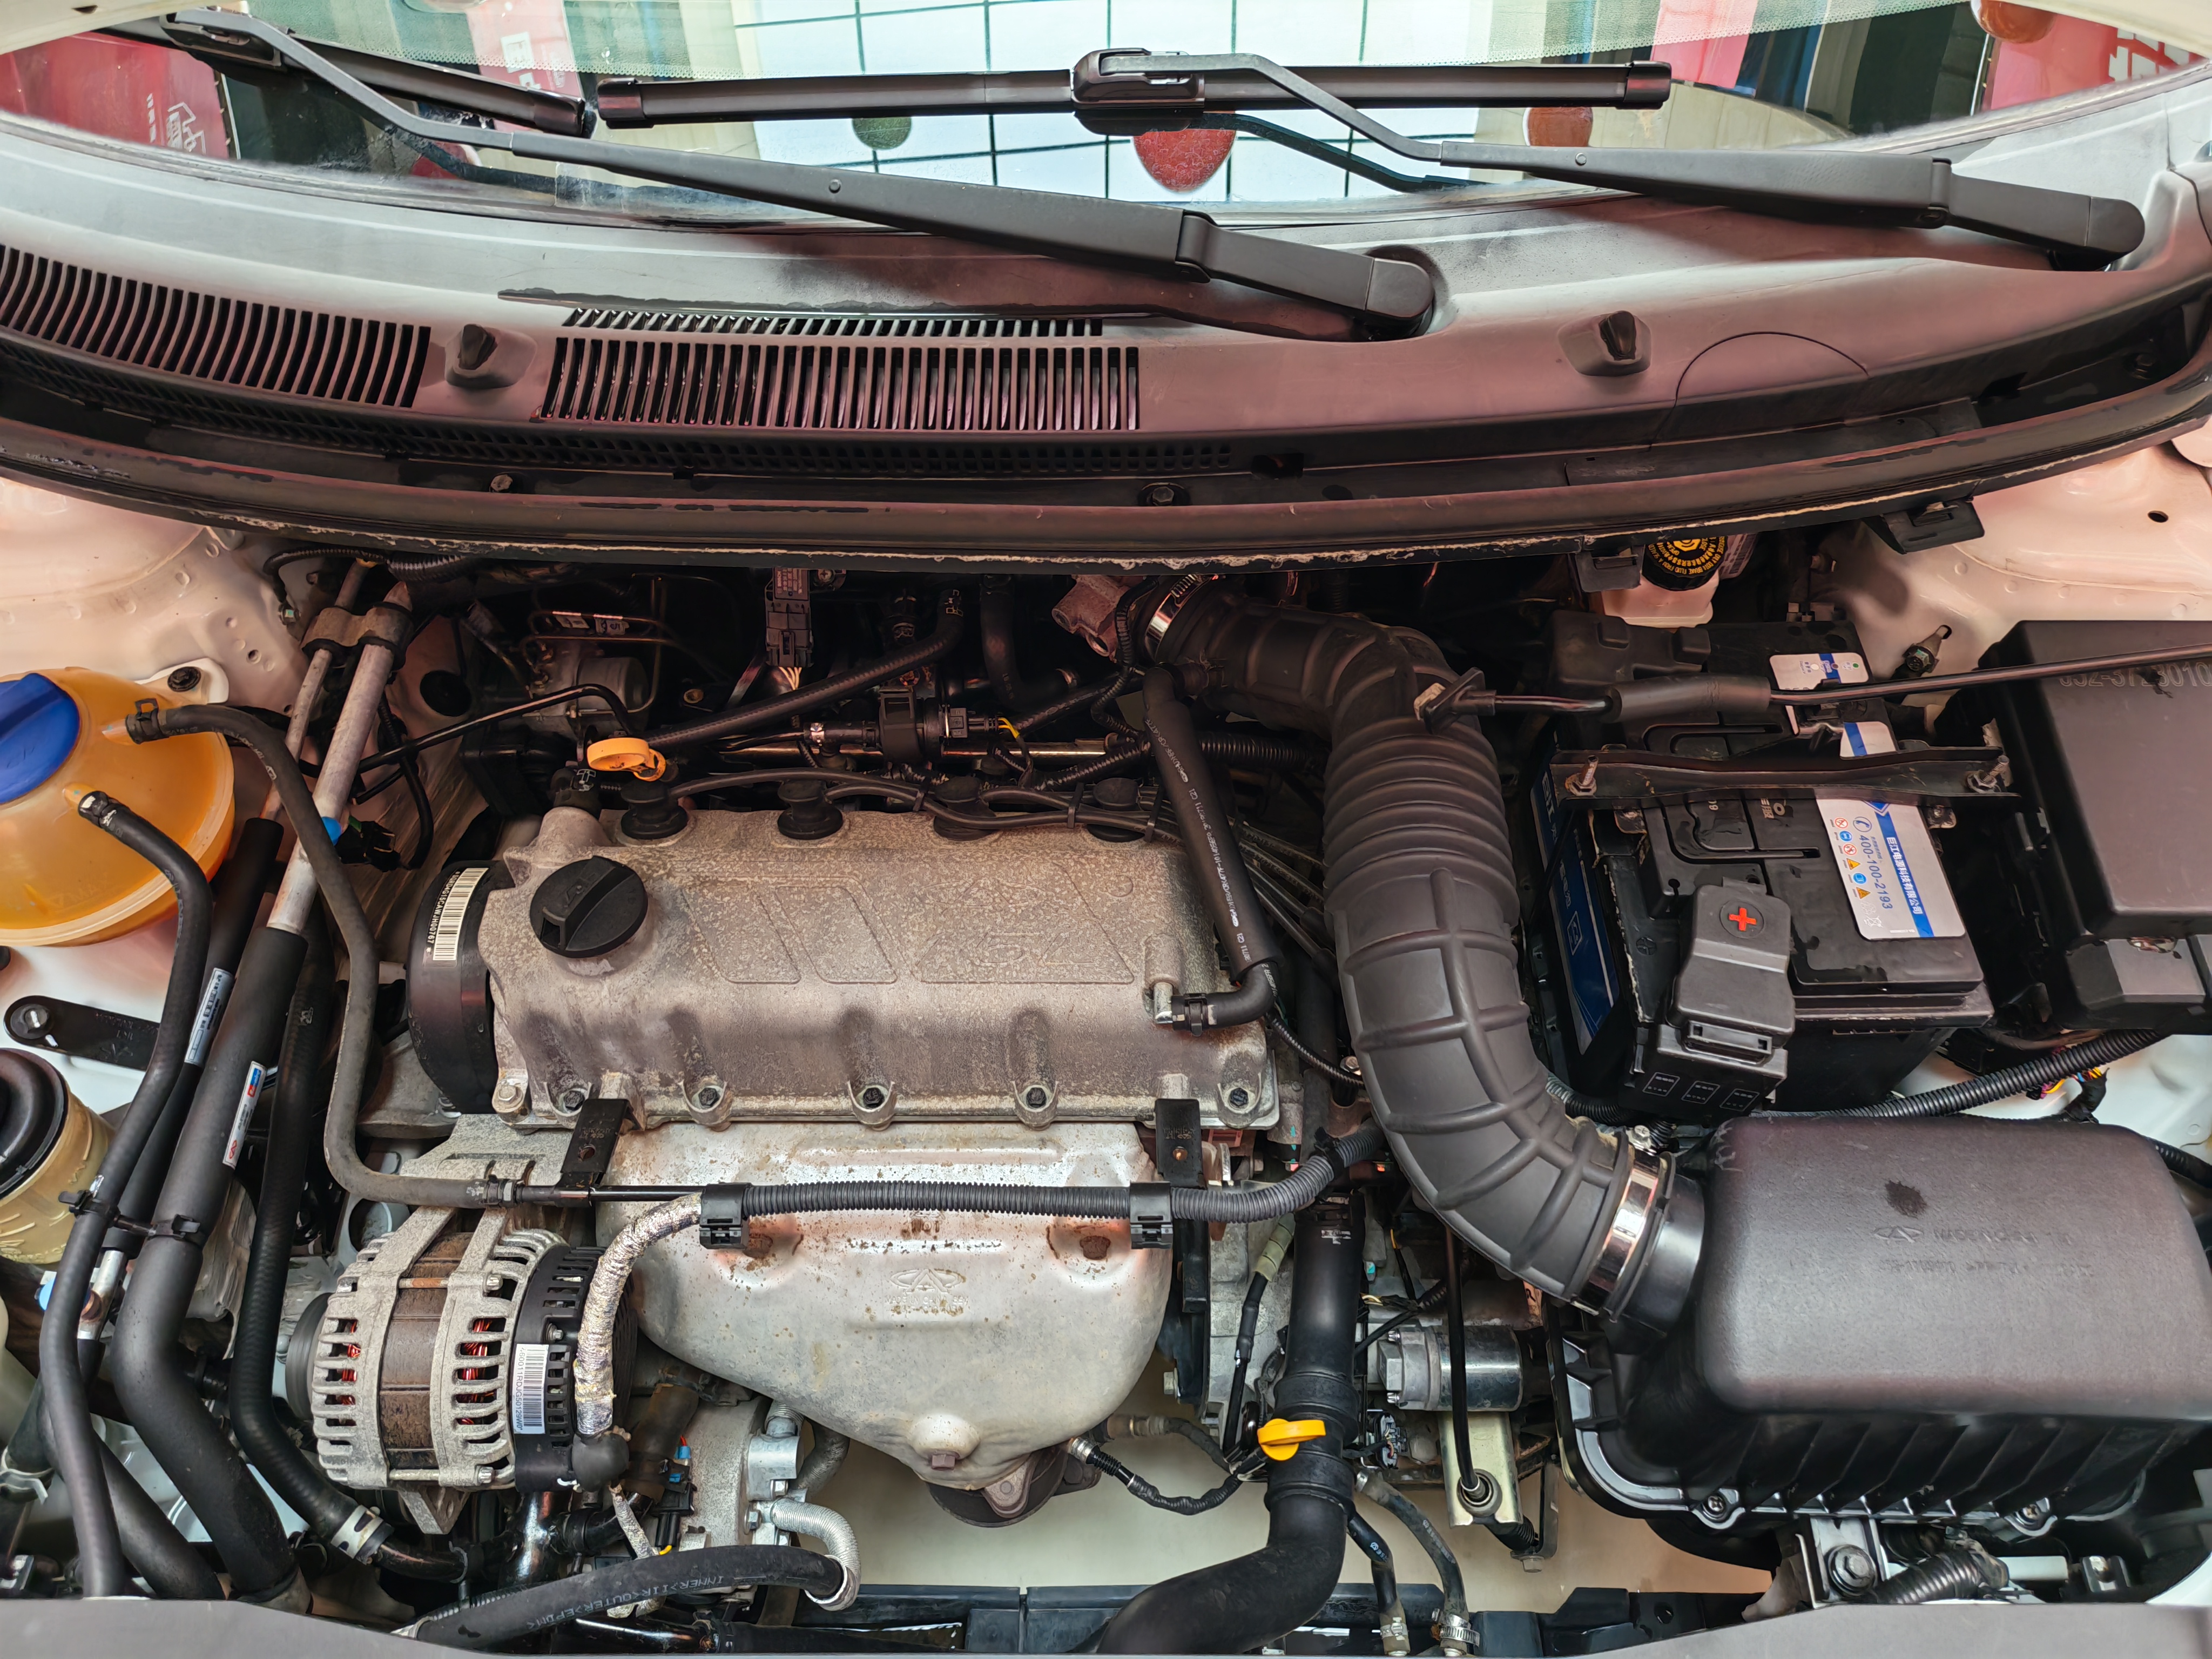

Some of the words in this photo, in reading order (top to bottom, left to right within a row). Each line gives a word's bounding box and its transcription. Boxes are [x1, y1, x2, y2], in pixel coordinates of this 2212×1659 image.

[1648, 544, 1658, 559] SEALED
[1667, 544, 1680, 556] OPEN
[1663, 561, 1674, 571] FROM
[1674, 566, 1687, 574] FLUID
[1688, 566, 1704, 576] BRAKE
[1858, 834, 1893, 911] 400-100-2193
[1886, 837, 1923, 915] 巨江电源科技有限公司
